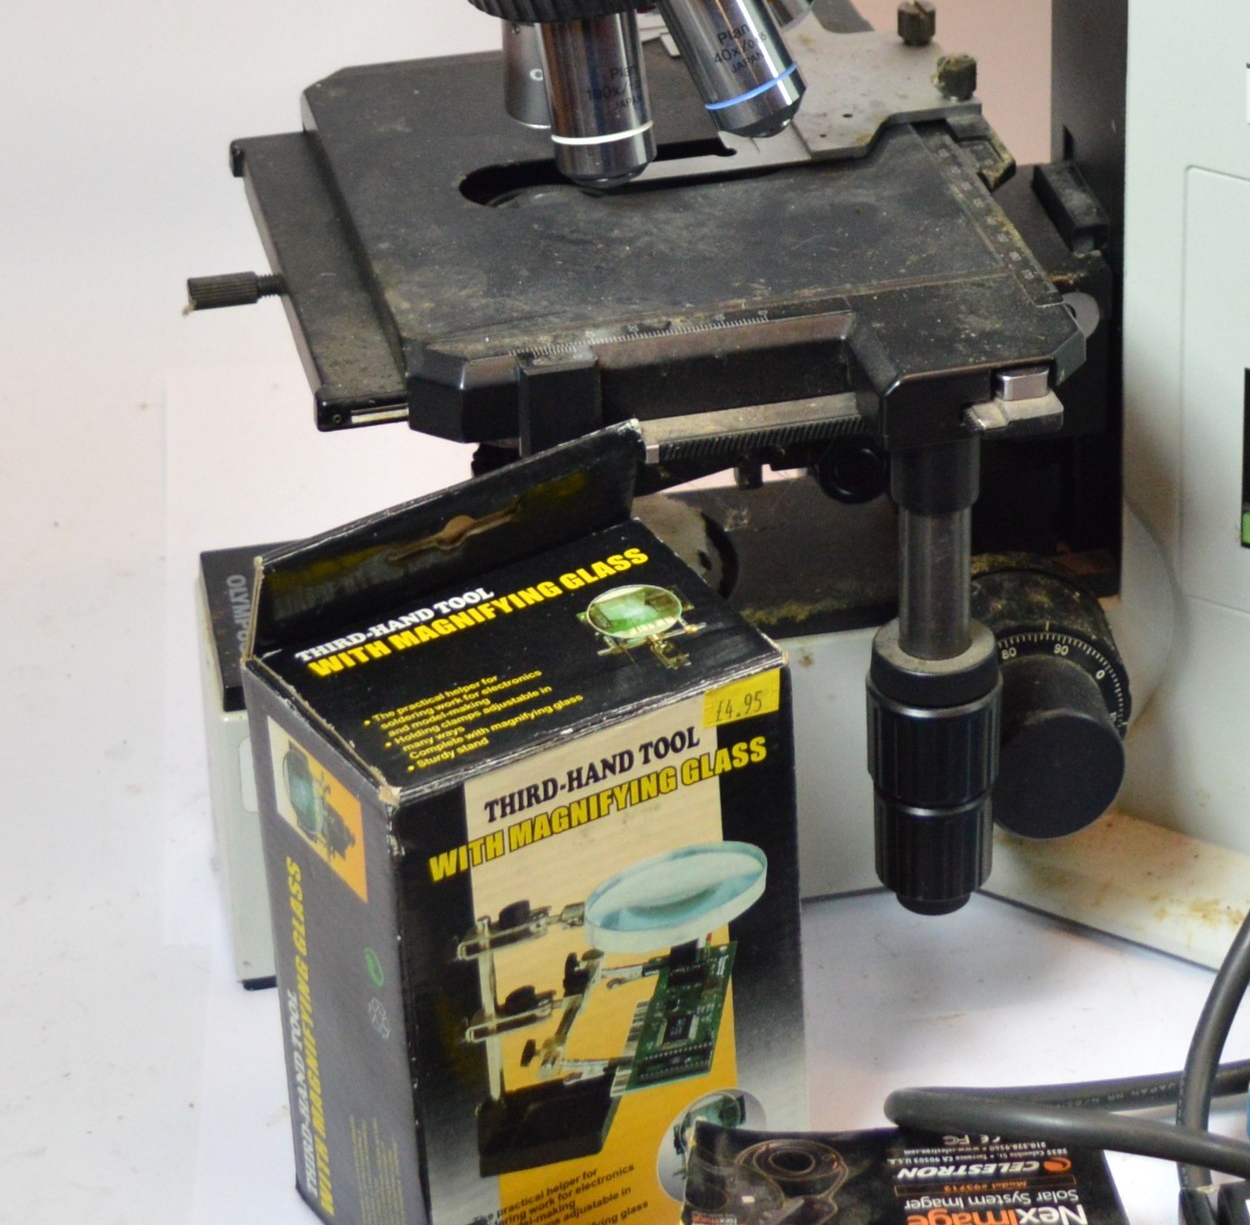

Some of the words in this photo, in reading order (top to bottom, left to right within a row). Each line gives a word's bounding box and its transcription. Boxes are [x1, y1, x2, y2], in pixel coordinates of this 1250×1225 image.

[717, 24, 750, 45] Plan
[295, 607, 435, 663] THIRD-HAND
[433, 587, 495, 615] TOOL
[307, 638, 392, 679] WITH
[391, 583, 564, 651] MAGNIFYING
[559, 547, 650, 591] GLASS
[1053, 644, 1070, 656] 90
[1096, 669, 1106, 680] 0
[371, 709, 395, 723] The
[396, 692, 445, 717] practical
[445, 680, 480, 699] helper
[480, 674, 499, 686] for
[380, 707, 435, 730] soldering
[434, 697, 463, 711] work
[463, 690, 480, 702] for
[481, 669, 543, 696] electronics
[387, 724, 405, 738] and
[405, 697, 491, 731] model-making
[393, 727, 440, 746] Holding
[440, 709, 482, 730] clamps
[482, 690, 540, 715] adjustable
[540, 685, 553, 696] in
[714, 689, 764, 722] £4.95
[402, 737, 434, 753] many
[435, 725, 466, 742] ways
[409, 737, 464, 760] Complete
[464, 726, 490, 742] with
[490, 705, 553, 734] magnifying
[553, 693, 584, 712] glass
[416, 750, 455, 769] Sturdy
[456, 737, 490, 754] stand
[484, 753, 635, 823] THIRD-HAND
[638, 725, 701, 765] TOOL
[428, 829, 506, 884] WITH
[508, 765, 678, 853] MAGNIFYING
[681, 735, 768, 787] GLASS
[285, 855, 308, 956] GLASS
[286, 988, 305, 1047] TOOL
[295, 956, 327, 1137] MAGNIFYING
[294, 1049, 318, 1198] THIRD-HAND
[315, 1137, 335, 1216] WITH
[496, 1191, 545, 1217] practical
[546, 1177, 580, 1198] helper
[582, 1168, 599, 1182] for
[528, 1198, 556, 1217] work
[556, 1189, 573, 1202] for
[574, 1163, 635, 1194] electronics
[897, 1160, 1041, 1179] CELESTRON
[563, 1192, 616, 1223] adjustable
[616, 1186, 633, 1199] in
[620, 1200, 649, 1220] glass
[904, 1195, 964, 1210] Imager
[907, 1204, 1089, 1225] NexImage
[967, 1190, 1031, 1205] System
[1036, 1189, 1079, 1203] Solar
